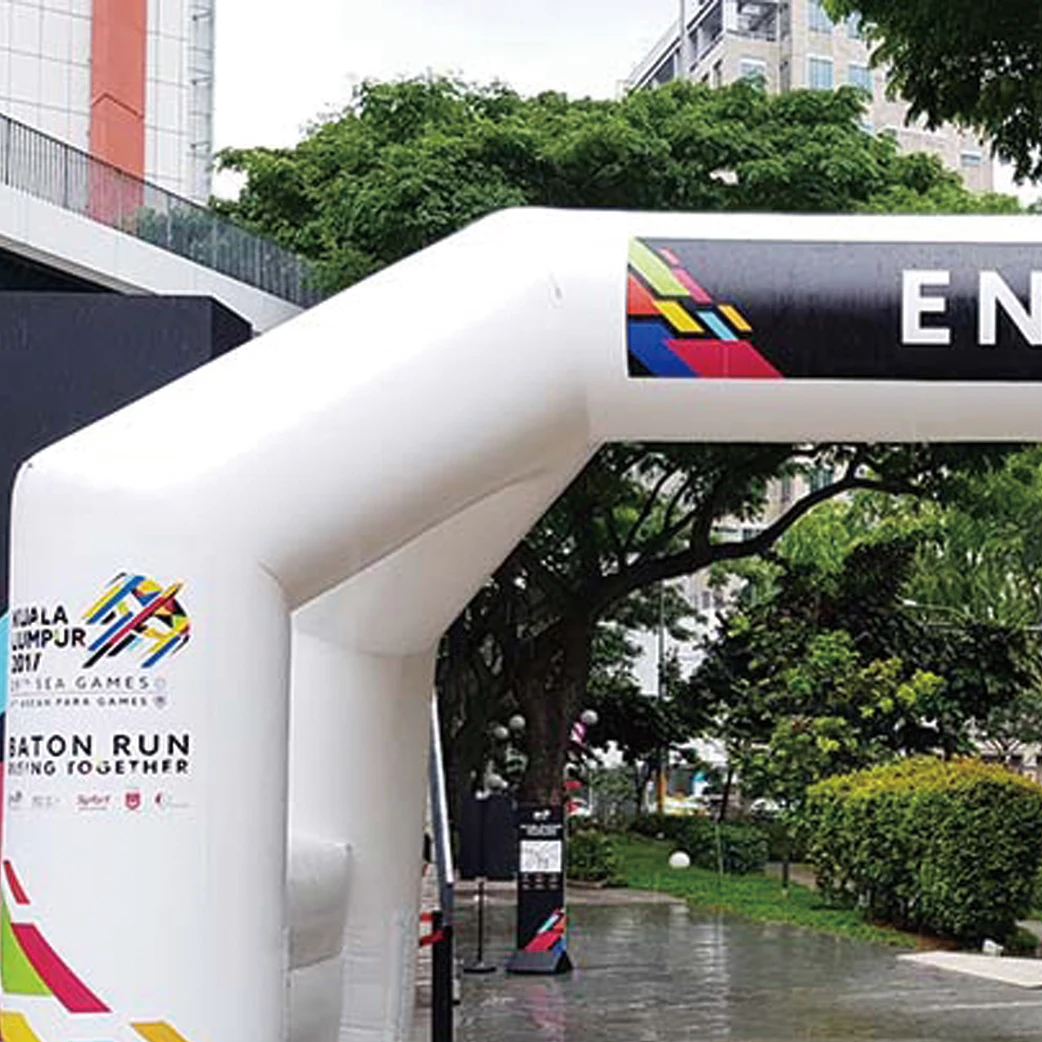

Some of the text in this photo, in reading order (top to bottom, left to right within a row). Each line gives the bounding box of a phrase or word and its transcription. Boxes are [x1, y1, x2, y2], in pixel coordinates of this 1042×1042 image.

[75, 675, 149, 690] GAMES
[8, 734, 190, 758] BATON RUN
[67, 760, 190, 776] TOGETHER
